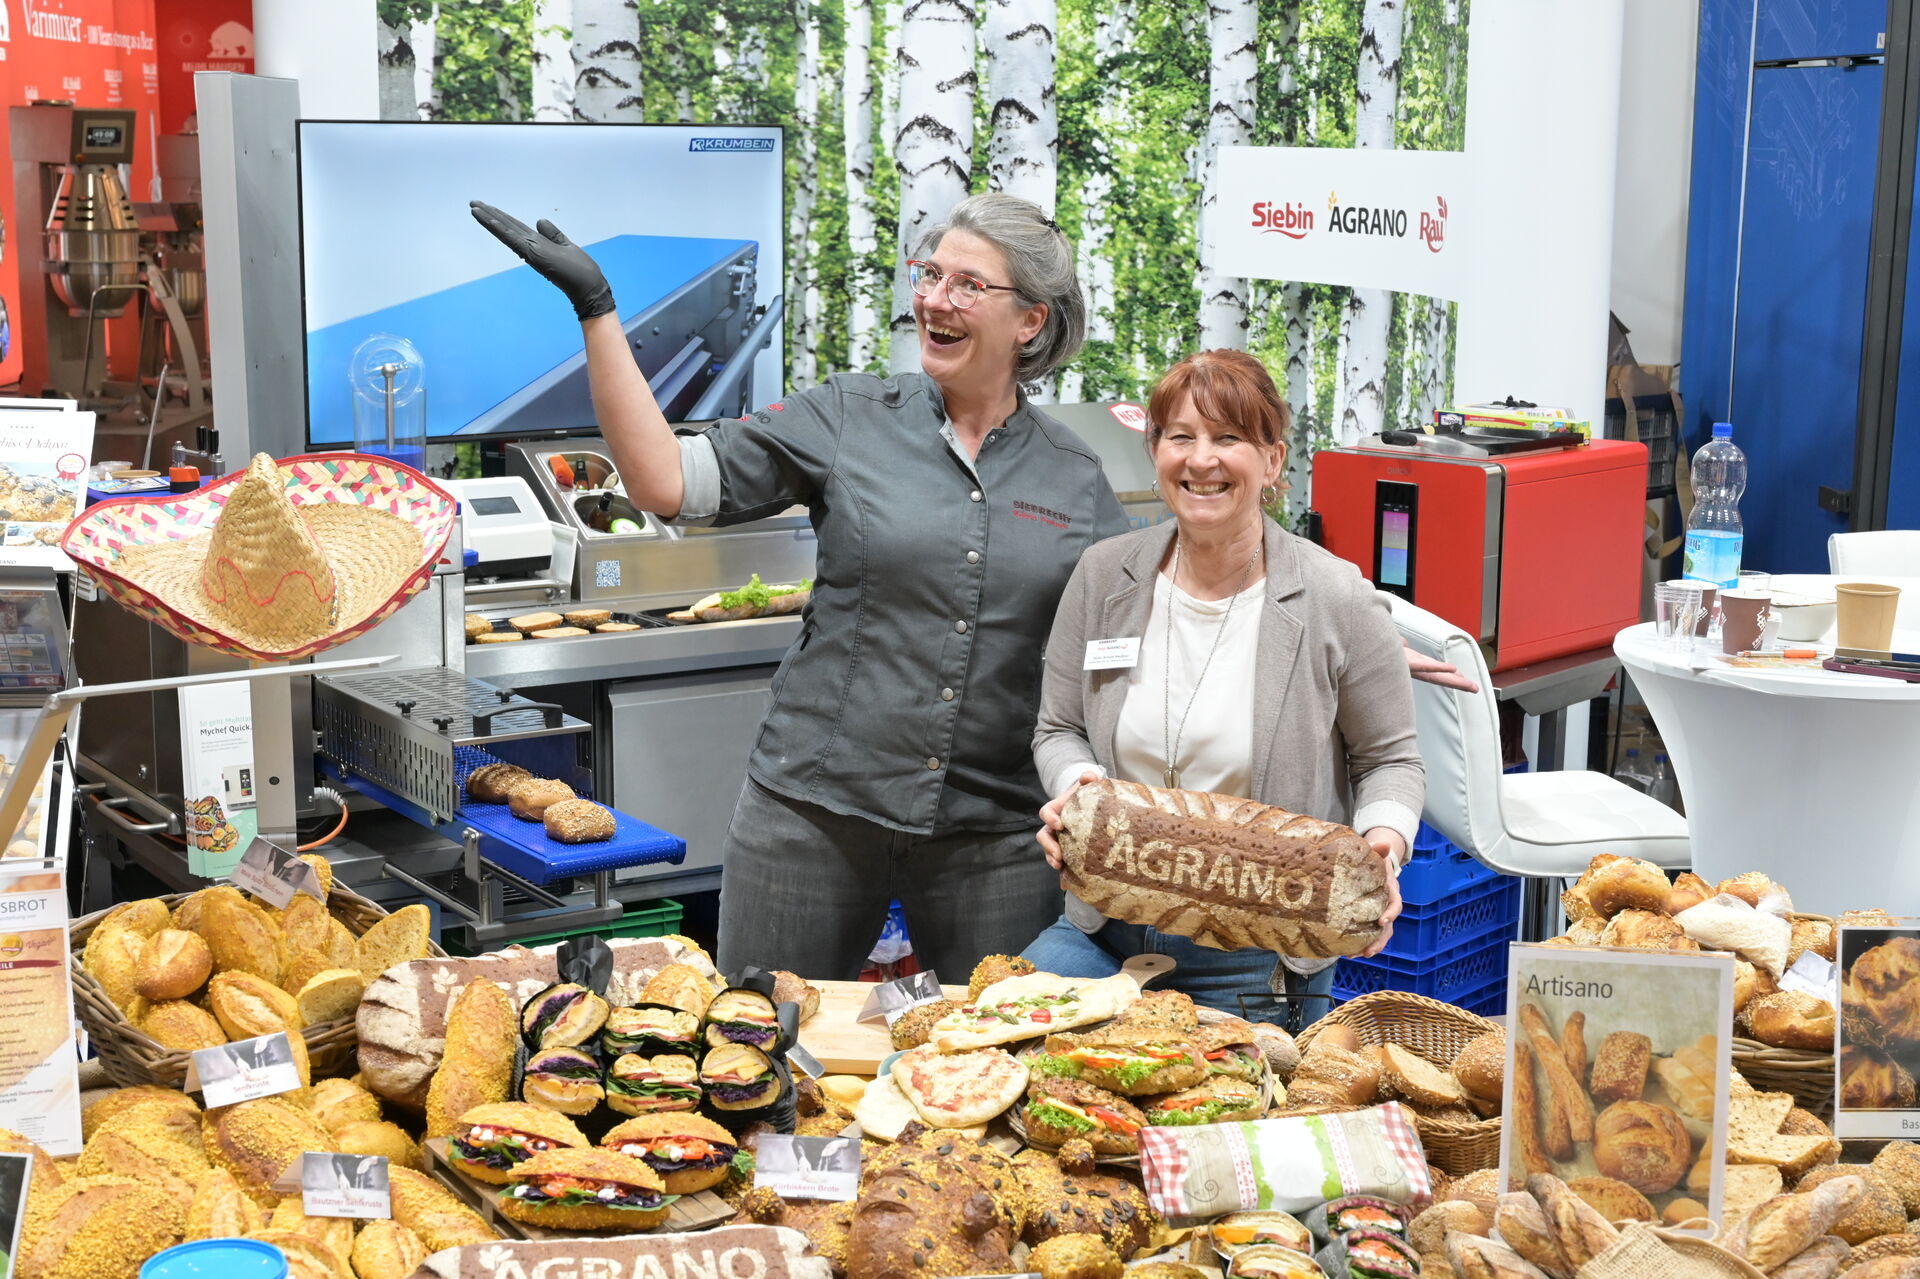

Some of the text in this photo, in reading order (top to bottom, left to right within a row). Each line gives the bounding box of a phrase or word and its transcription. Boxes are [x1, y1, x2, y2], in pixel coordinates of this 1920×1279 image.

[22, 0, 82, 43] Varimixer
[705, 139, 774, 149] KRUMBEIN
[1251, 201, 1446, 247] Siebin AGRANO Rau
[1116, 408, 1146, 423] NEW
[200, 726, 227, 736] Mychef
[1103, 833, 1314, 910] AGRANO
[0, 898, 48, 914] SBROT
[1525, 974, 1613, 999] Artisano
[1902, 1119, 1920, 1130] Bas
